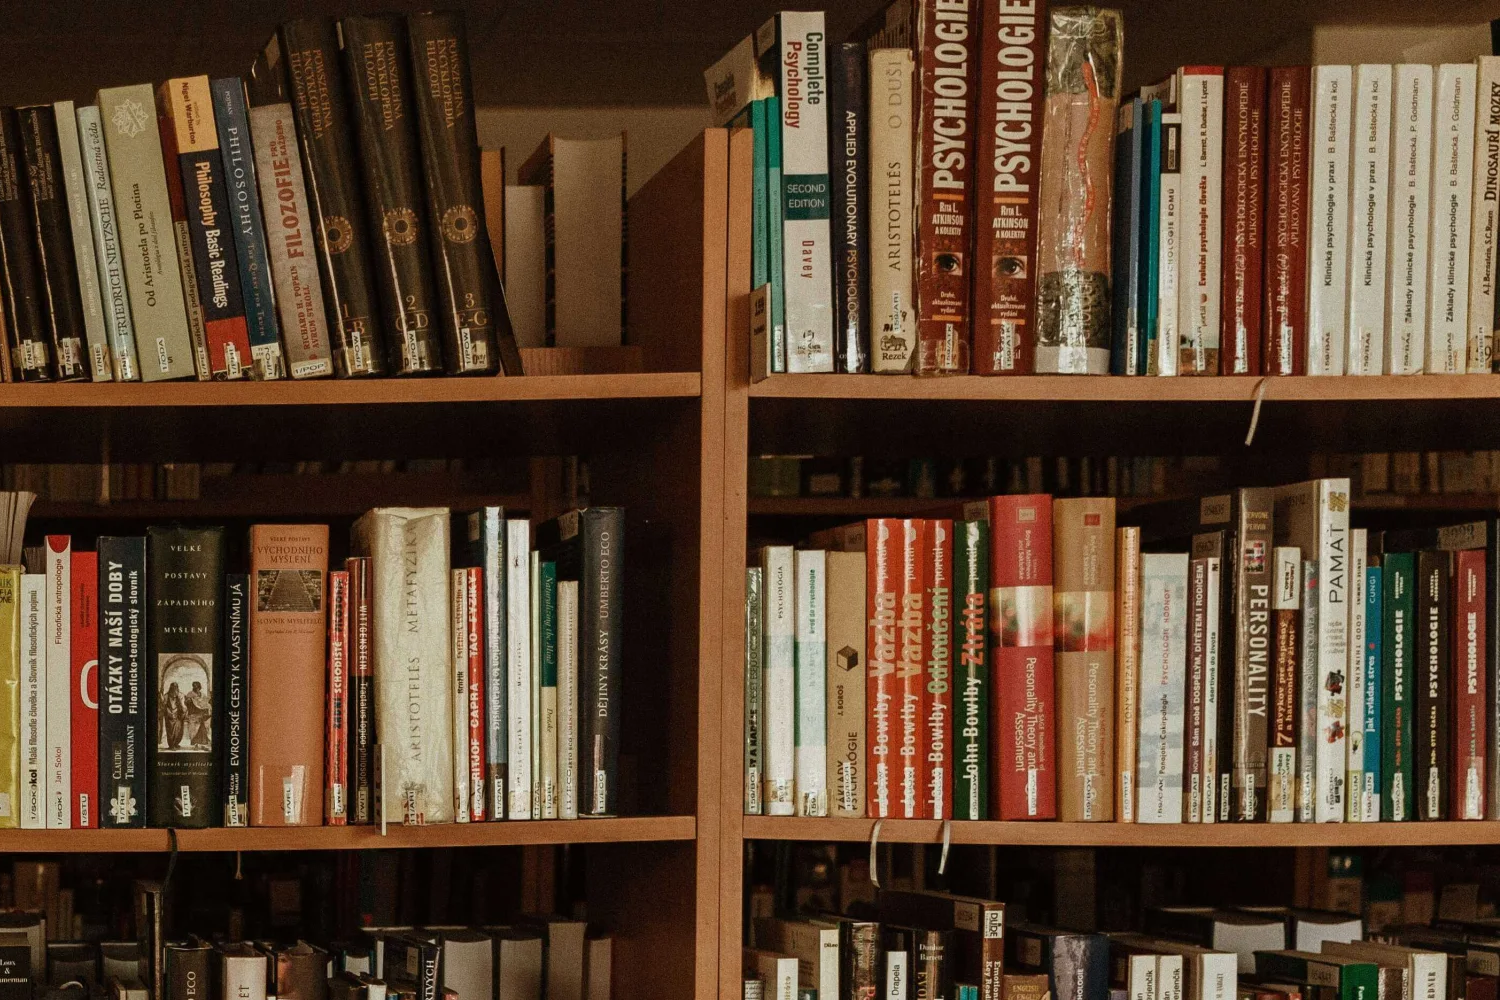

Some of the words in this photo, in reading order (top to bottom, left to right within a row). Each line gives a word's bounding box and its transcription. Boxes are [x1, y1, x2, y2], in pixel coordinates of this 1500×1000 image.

[784, 41, 802, 129] Psychology
[804, 31, 824, 106] Complete
[195, 161, 217, 227] Philosophy
[787, 184, 825, 194] SECOND
[788, 198, 825, 208] EDITION
[205, 228, 222, 258] Basic
[800, 240, 814, 279] Davey
[210, 258, 228, 309] Readings
[600, 532, 610, 555] ECO
[109, 560, 123, 603] DOBY
[601, 559, 610, 619] UMBERTO
[869, 591, 896, 679] Vazba
[961, 593, 984, 666] Ztráta
[1249, 585, 1268, 718] PERSONALITY
[1395, 610, 1404, 701] PSYCHOLOGIE
[1429, 606, 1438, 698] PSYCHOLOGIE
[106, 655, 123, 715] OTÁZKY
[963, 678, 981, 737] Bowlby
[873, 692, 891, 756] Bowlby
[928, 702, 946, 762] Bowlby
[187, 971, 196, 996] ECO
